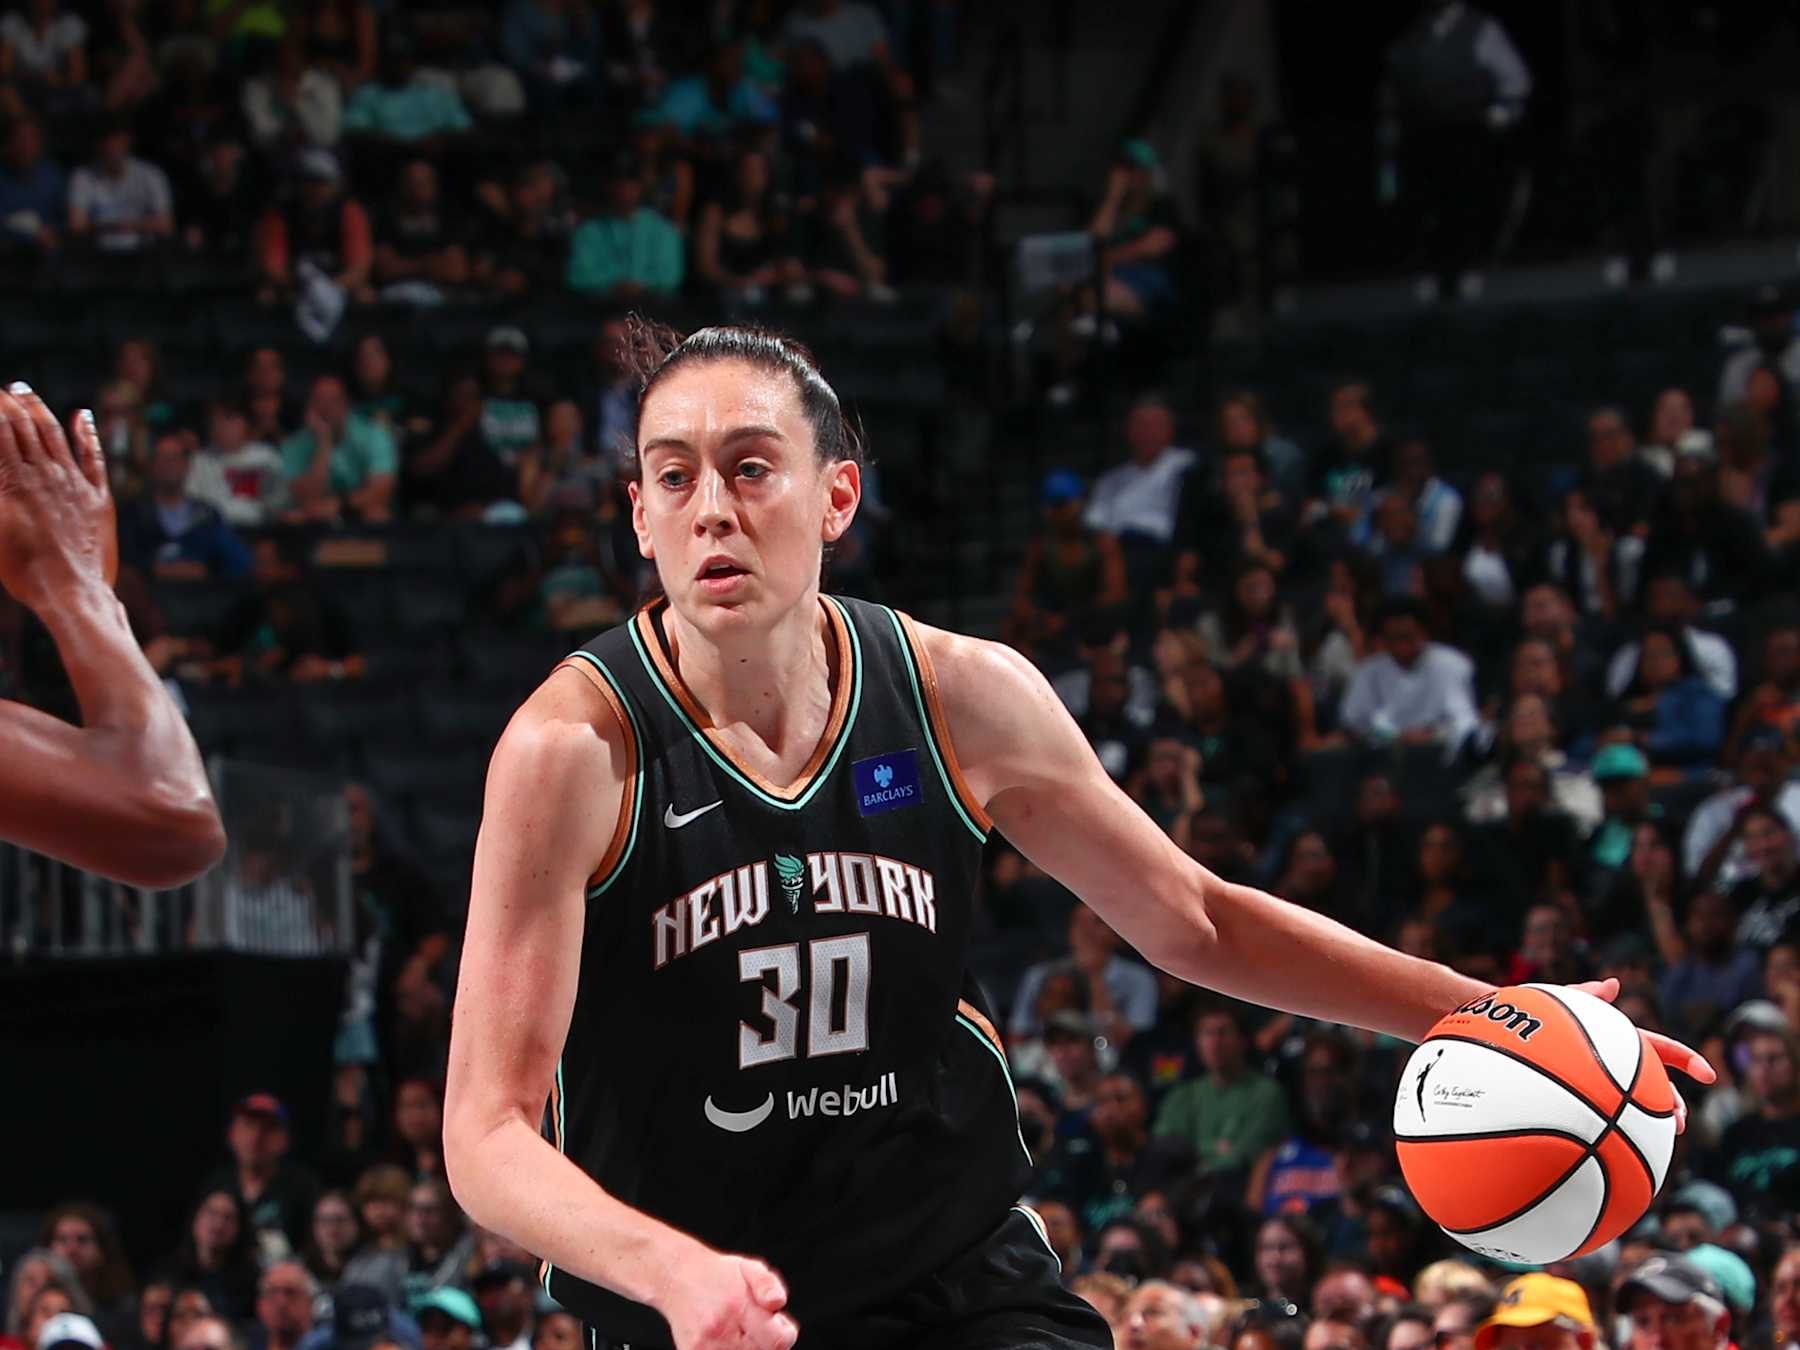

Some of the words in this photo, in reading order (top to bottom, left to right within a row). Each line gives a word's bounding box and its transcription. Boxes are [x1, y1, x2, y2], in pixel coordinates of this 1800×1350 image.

[863, 785, 914, 807] BARCLAYS
[653, 860, 770, 970] NEW
[806, 851, 937, 935] YORK
[738, 931, 871, 1070] 30
[1450, 990, 1543, 1043] lson
[786, 1071, 898, 1120] Webull
